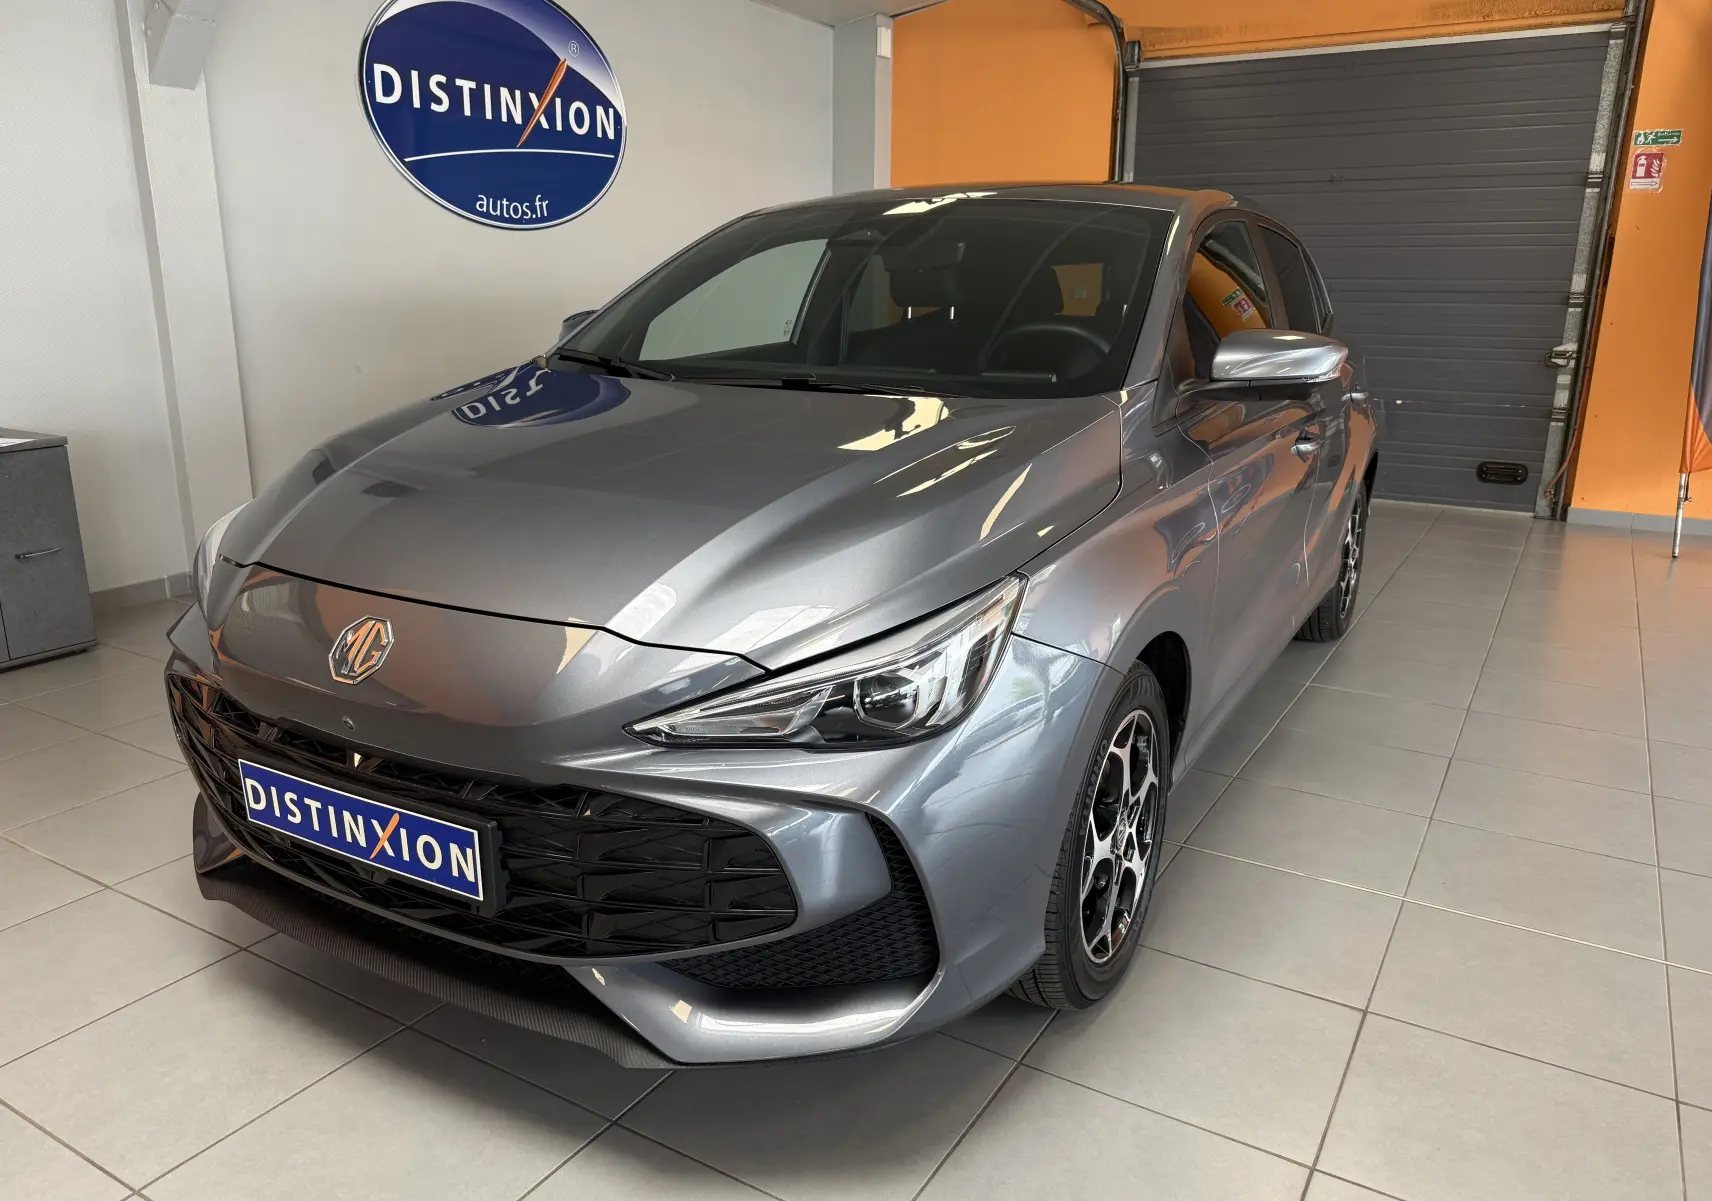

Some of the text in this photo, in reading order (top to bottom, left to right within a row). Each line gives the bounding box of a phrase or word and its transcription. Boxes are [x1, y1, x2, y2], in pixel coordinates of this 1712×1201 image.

[373, 58, 615, 147] DISTINXION
[475, 194, 549, 219] autos.fr
[336, 620, 388, 677] MG
[244, 777, 476, 883] DISTINXION
